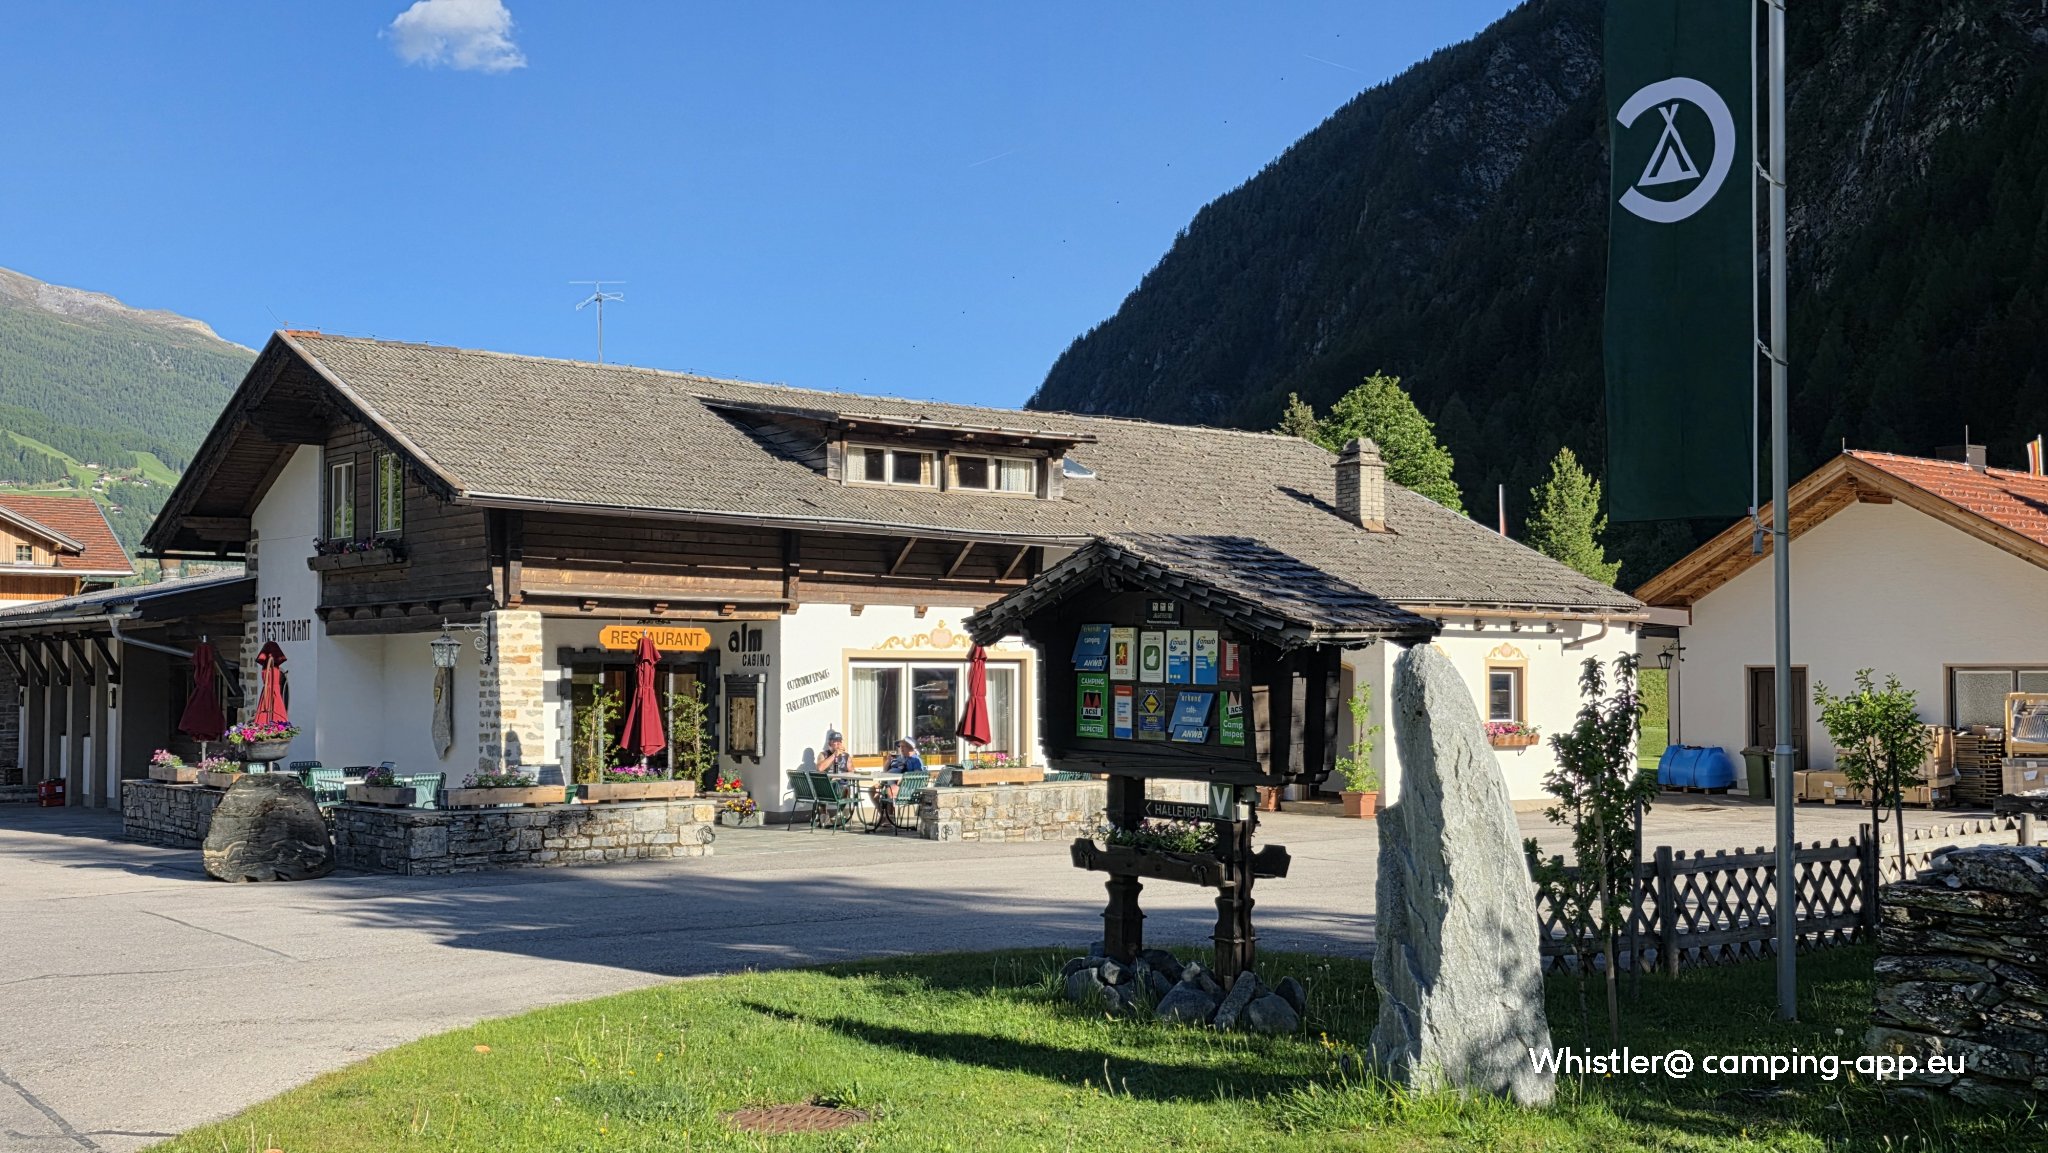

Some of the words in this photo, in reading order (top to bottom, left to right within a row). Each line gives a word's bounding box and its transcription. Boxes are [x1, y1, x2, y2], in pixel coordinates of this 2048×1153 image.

[262, 597, 281, 618] CAFE
[262, 619, 311, 642] RESTAURANT
[728, 622, 762, 652] alm
[611, 630, 702, 646] RESAURANT
[742, 654, 770, 667] CASINO
[1083, 659, 1103, 667] ANWB
[1081, 677, 1105, 685] CAMPING
[1080, 724, 1104, 733] INSPECTED
[1181, 729, 1203, 739] ANWB
[1222, 730, 1244, 739] Inspec
[1154, 803, 1208, 819] HALLENBAD
